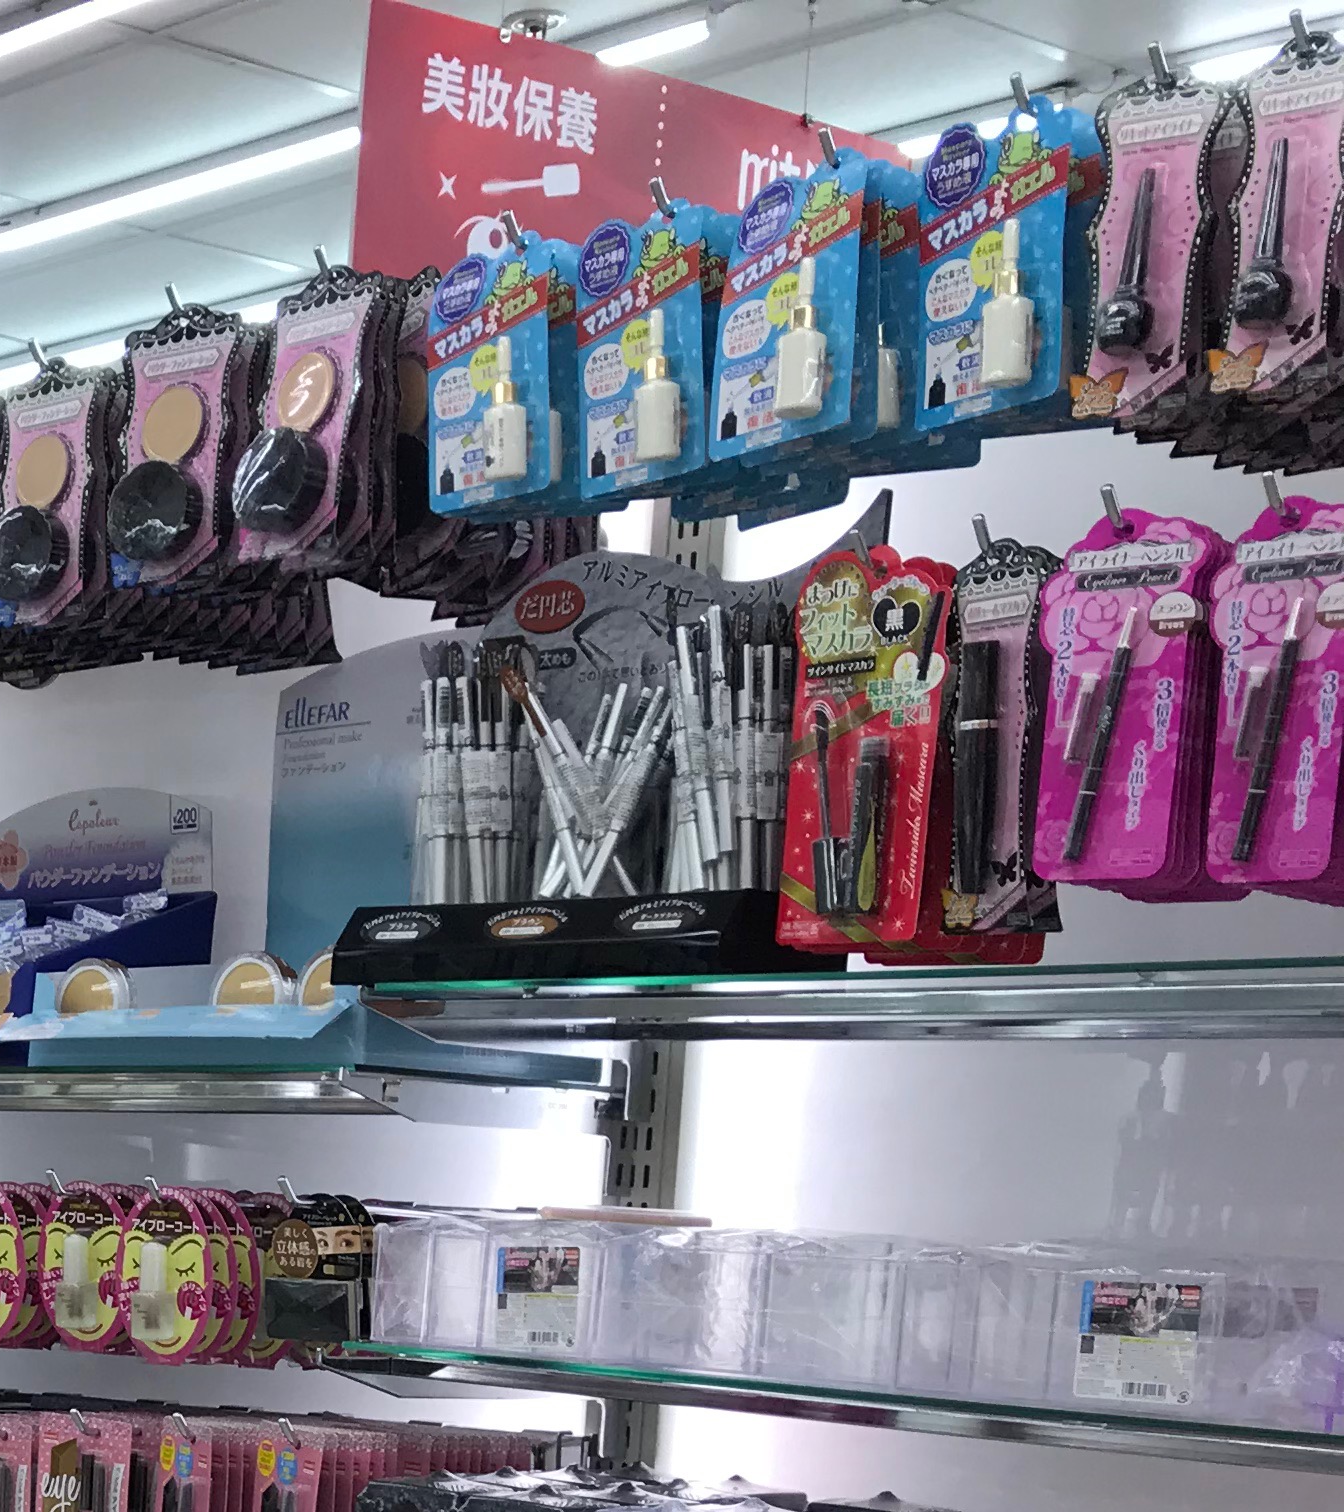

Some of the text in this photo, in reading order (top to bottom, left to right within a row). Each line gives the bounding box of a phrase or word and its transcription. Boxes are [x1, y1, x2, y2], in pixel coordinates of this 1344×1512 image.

[422, 53, 598, 154] 美妝保養
[582, 560, 784, 611] アルミアイブローンシル
[1083, 568, 1175, 590] Eyeliner Pencil
[520, 590, 577, 620] だ円芯
[800, 604, 856, 632] フィット
[885, 608, 904, 631] 黒
[803, 627, 873, 658] マスカラ
[880, 635, 910, 646] BLACK
[281, 761, 346, 778] ファンデーション
[28, 862, 162, 889] パウダーファンデーション
[51, 1210, 119, 1225] アイブローコート
[132, 1218, 200, 1233] アイブローコート
[283, 1227, 308, 1239] 美しく
